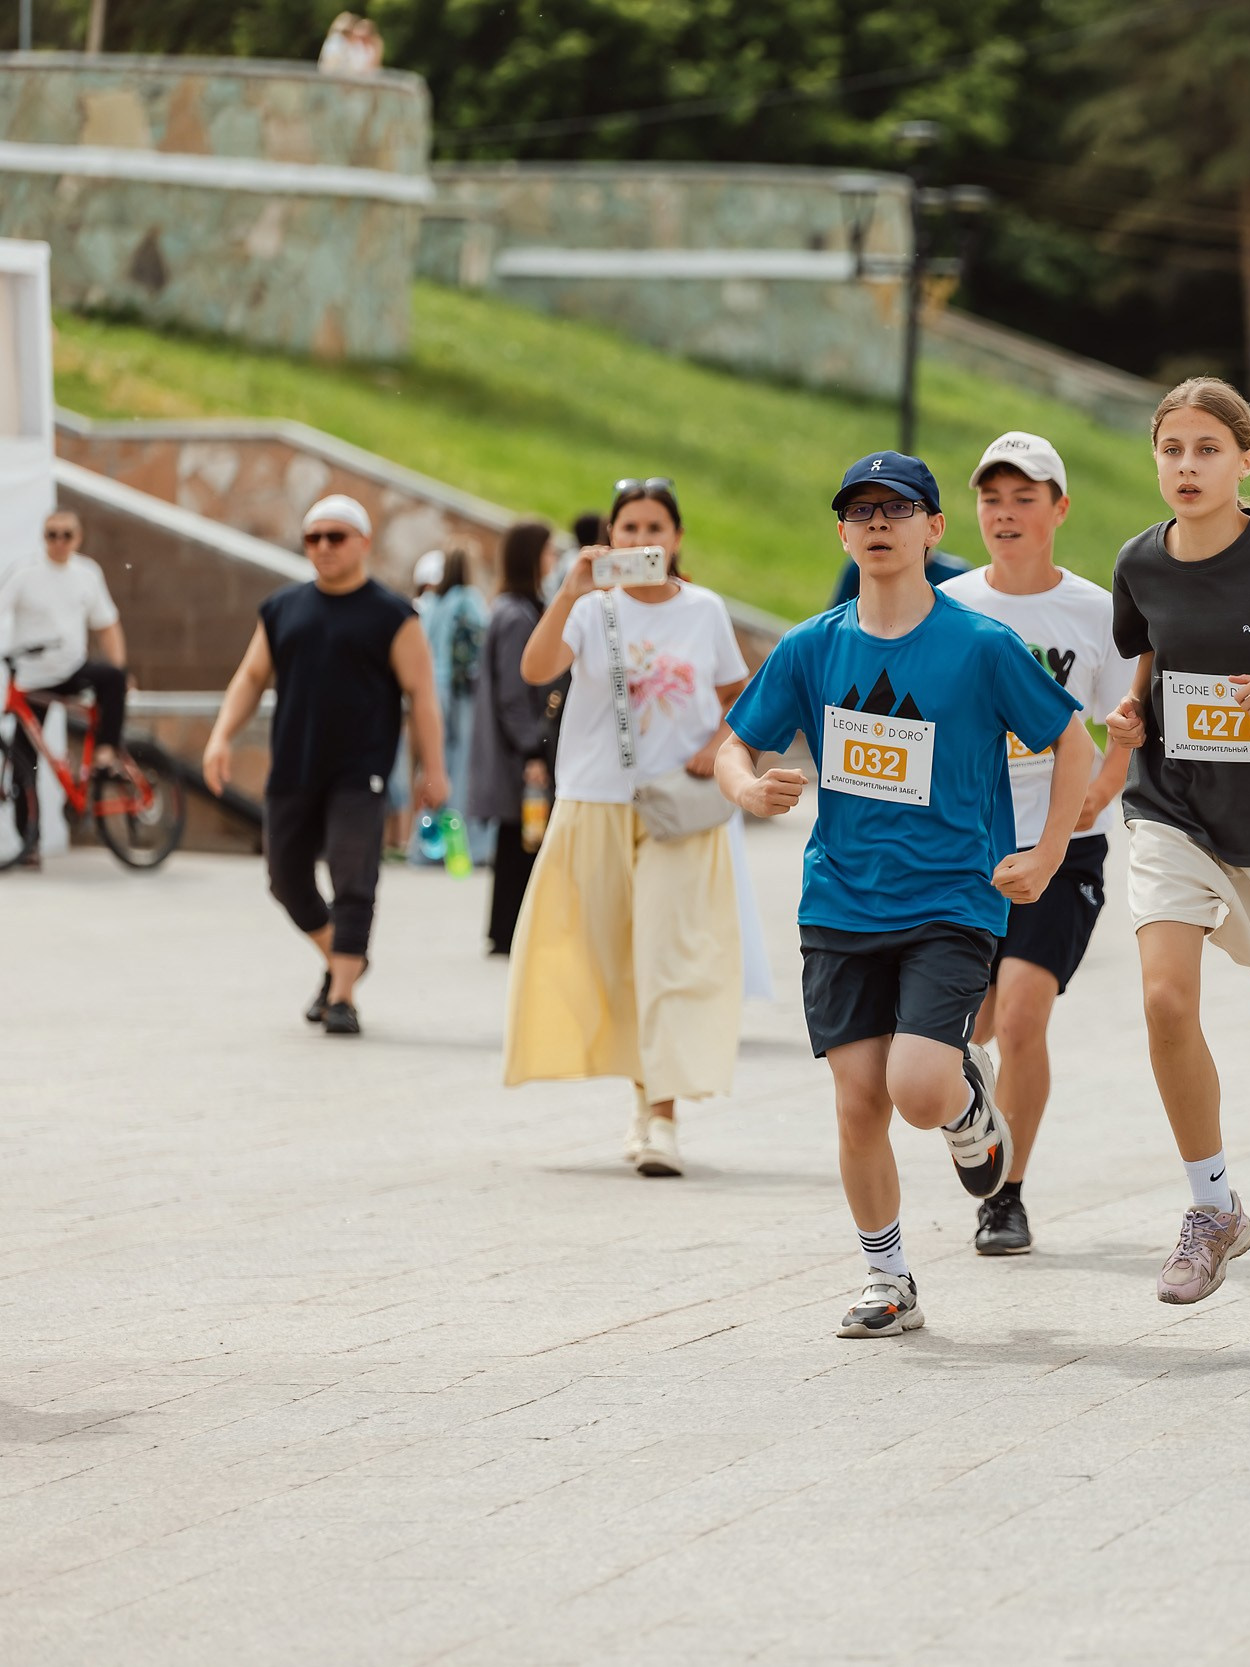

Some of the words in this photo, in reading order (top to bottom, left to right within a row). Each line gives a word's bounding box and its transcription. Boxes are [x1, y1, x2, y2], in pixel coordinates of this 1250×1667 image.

[1172, 683, 1210, 696] LEONE
[833, 718, 869, 734] LEONE
[888, 728, 924, 742] D'ORO
[1193, 709, 1246, 737] 427
[1175, 743, 1249, 753] БЛАГОТВОРИТЕЛЬНЫЙ
[849, 745, 900, 777] 032
[831, 774, 898, 793] БЛАГОТВОРИТЕЛЬНЫЙ
[898, 787, 918, 795] ЗАБЕГ
